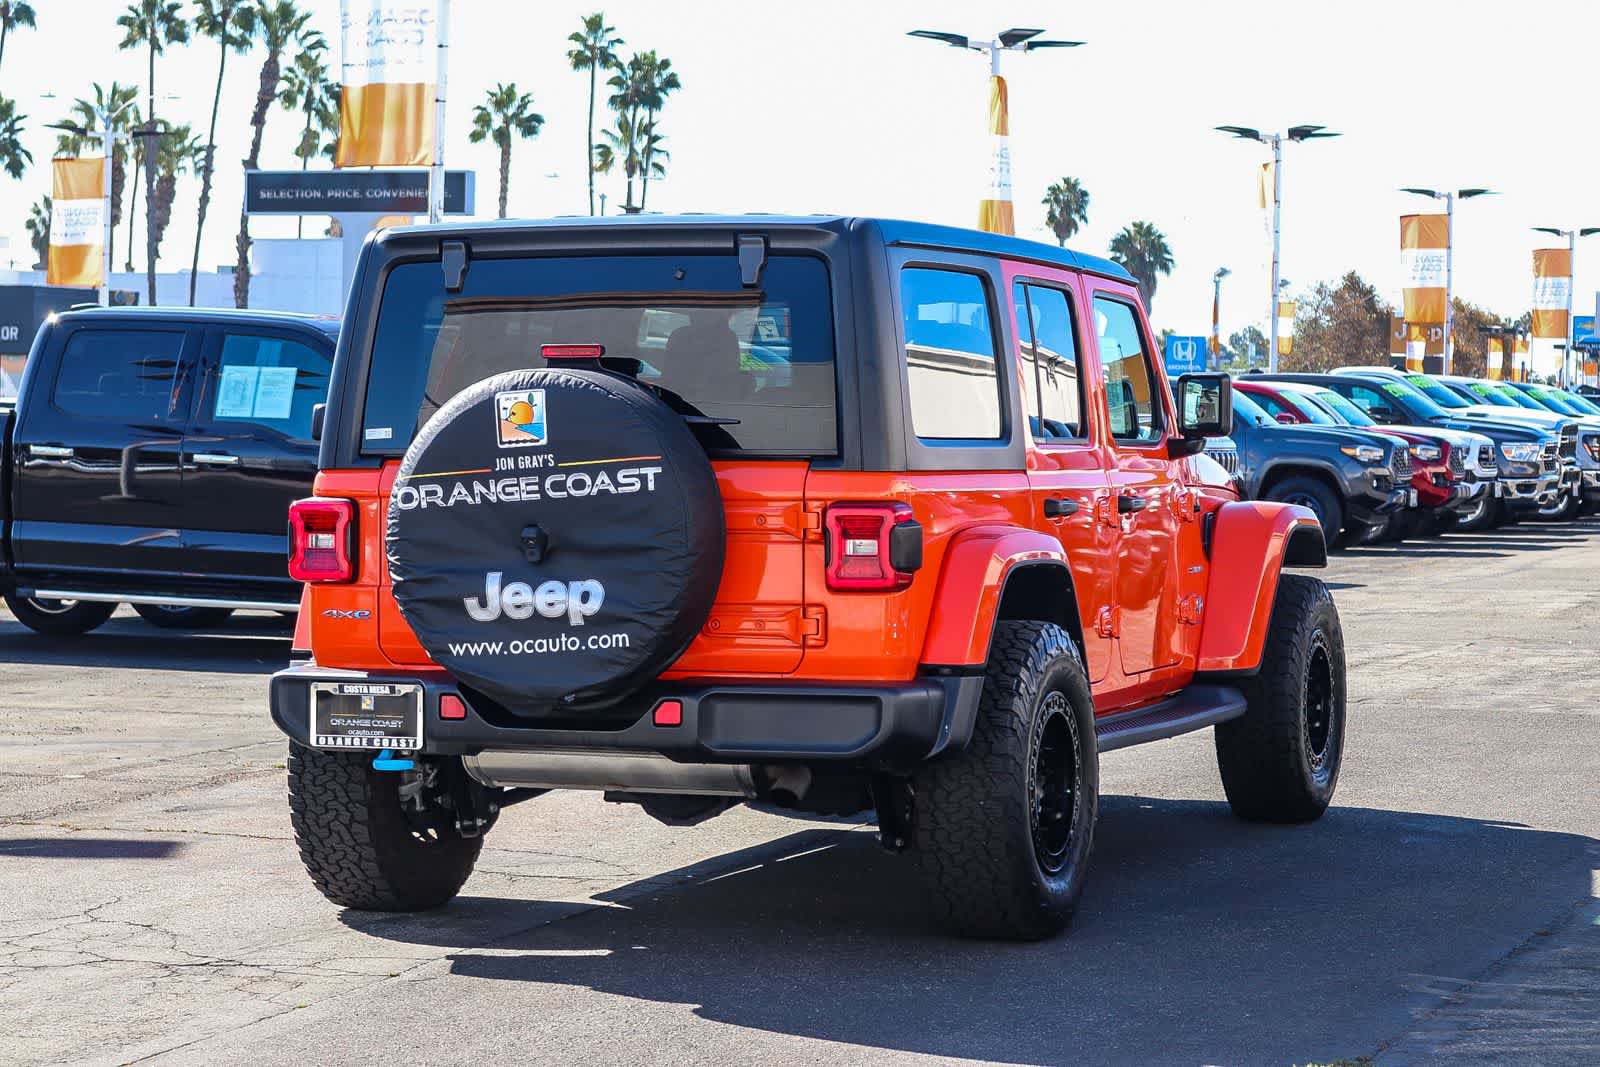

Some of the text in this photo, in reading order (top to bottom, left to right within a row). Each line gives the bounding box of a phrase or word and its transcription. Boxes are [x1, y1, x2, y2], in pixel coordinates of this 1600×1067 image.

[259, 188, 325, 200] SELECTION.
[327, 188, 363, 199] PRICE.
[495, 453, 555, 471] JON GRAY'S
[397, 466, 663, 511] ORANGE COAST
[463, 571, 606, 626] Jeep
[448, 633, 630, 656] www.ocauto.com
[343, 685, 391, 694] COSTA MESA
[330, 718, 404, 728] ORANGE COAST
[318, 736, 417, 748] ORANGE COAST
